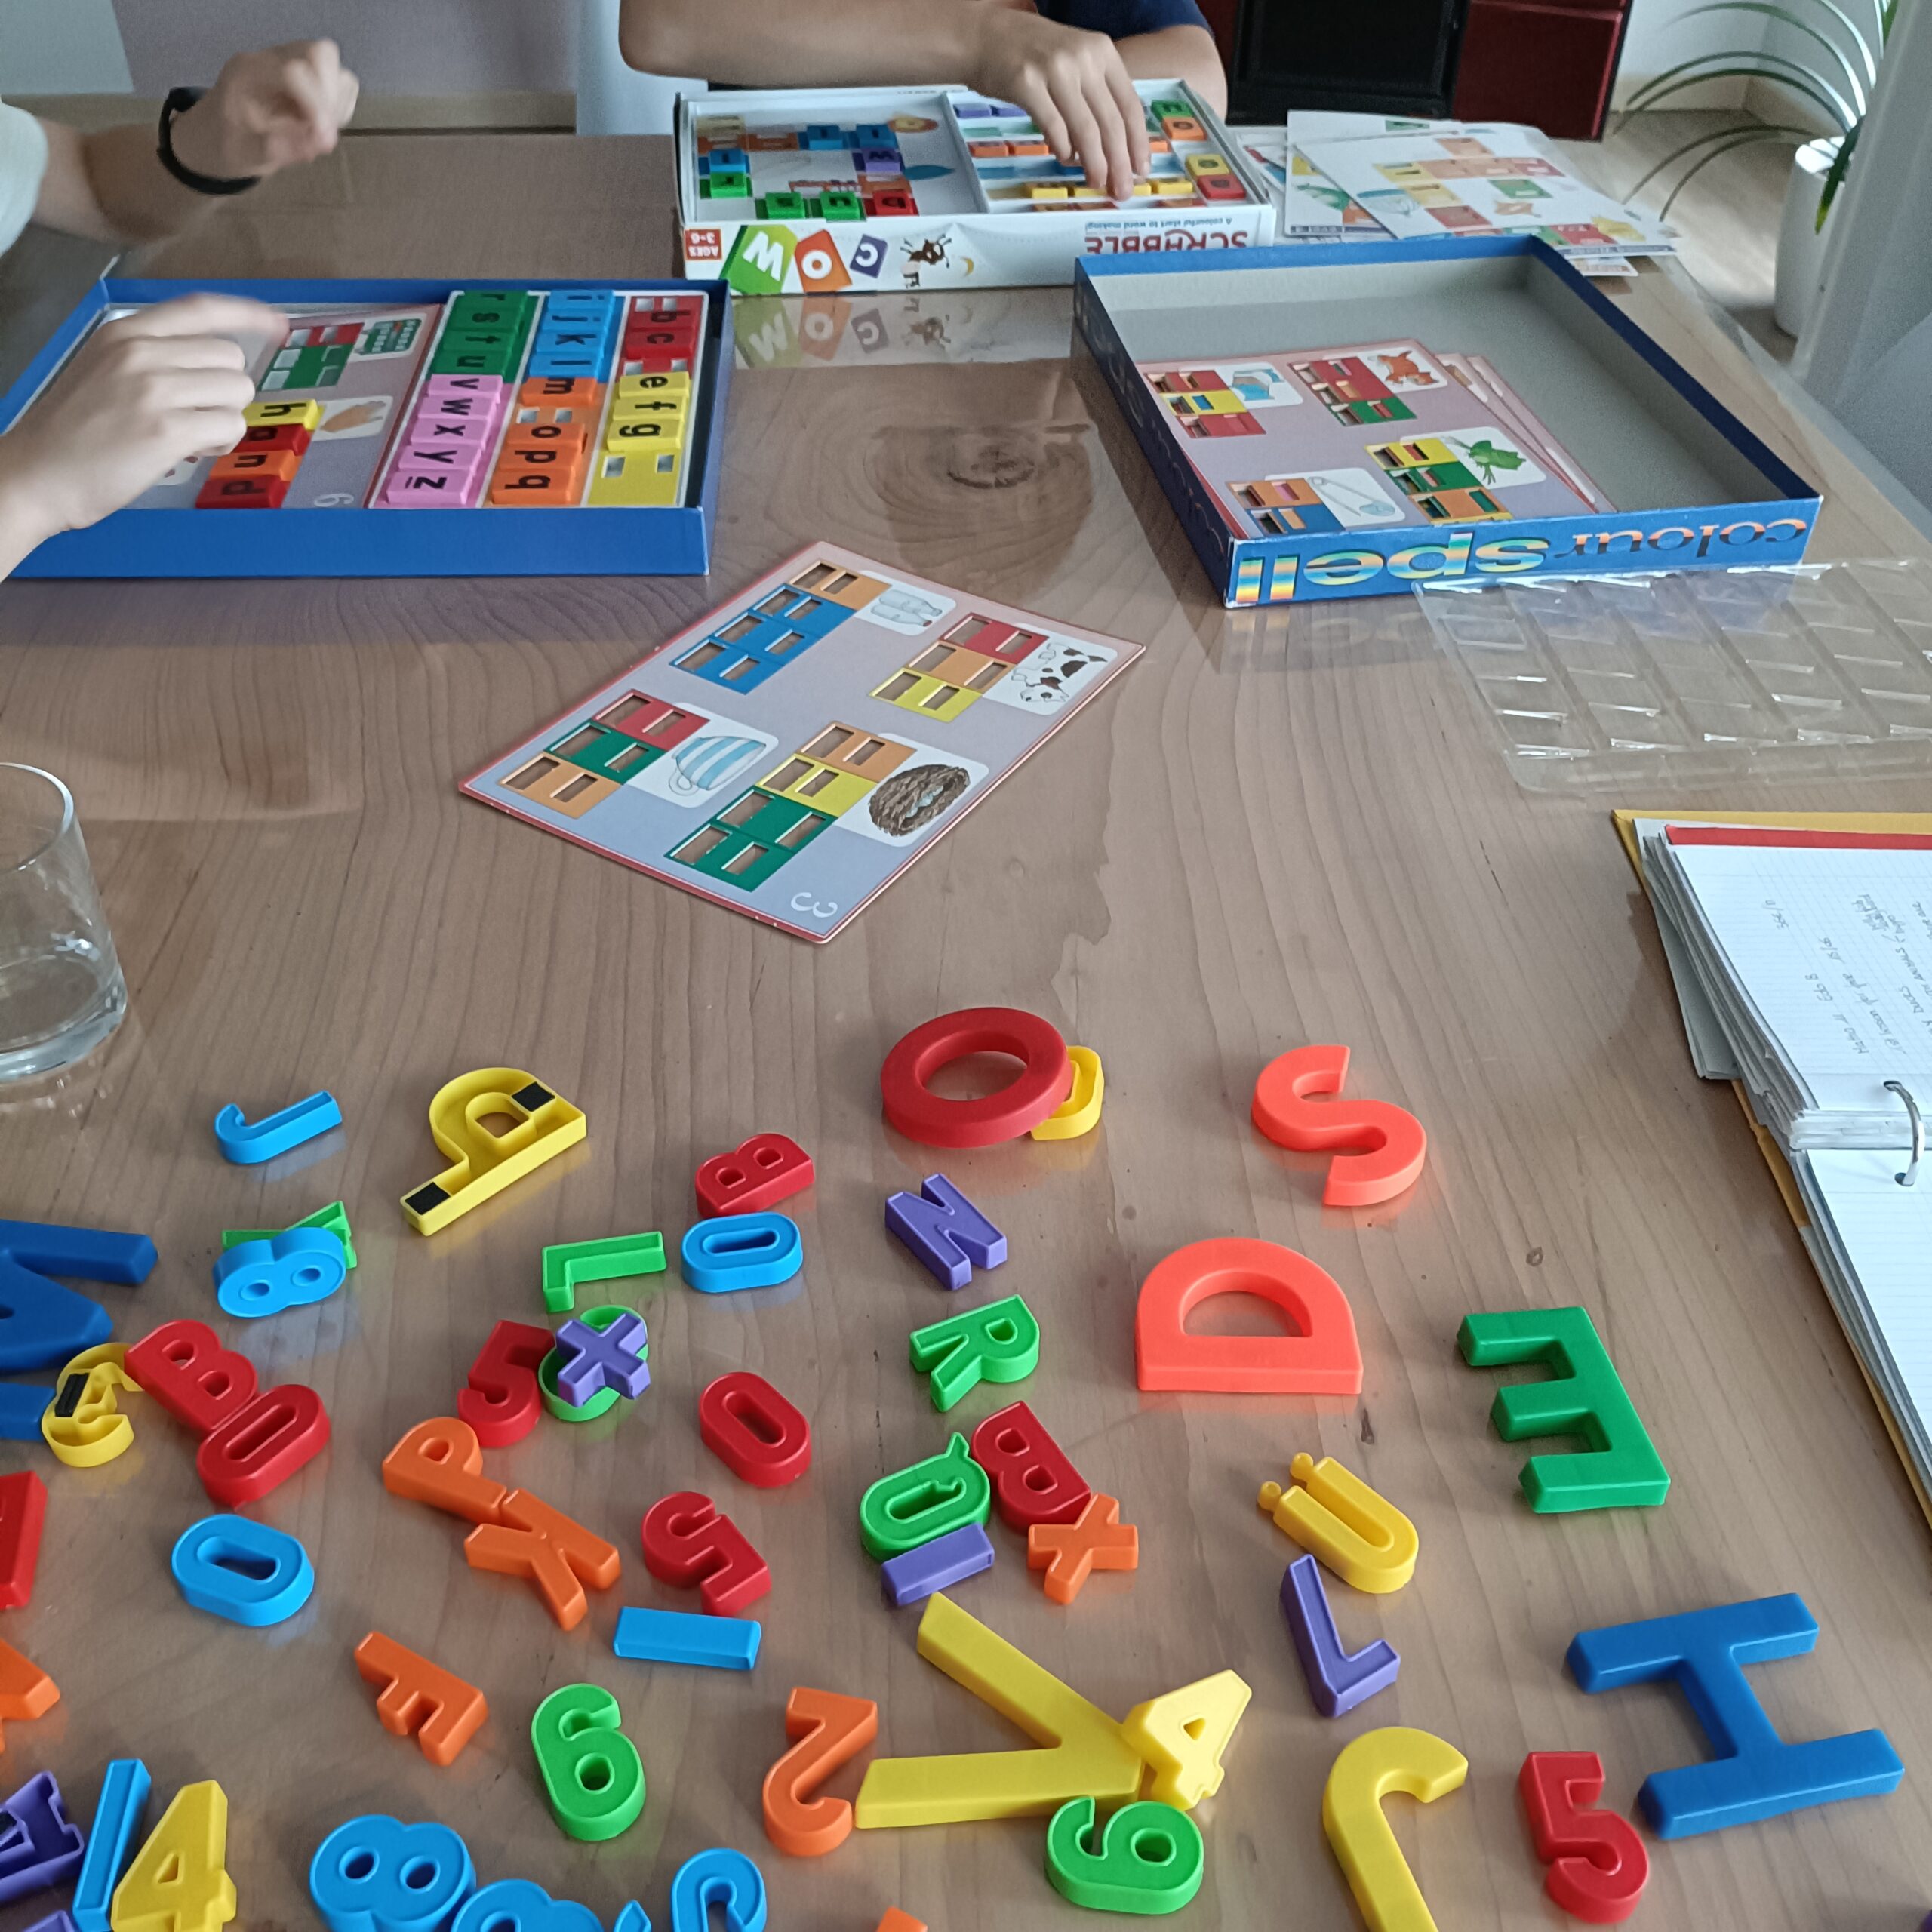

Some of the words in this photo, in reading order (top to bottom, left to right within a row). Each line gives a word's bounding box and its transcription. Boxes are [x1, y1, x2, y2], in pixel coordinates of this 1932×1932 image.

[689, 246, 718, 257] AGES
[640, 377, 668, 388] e
[1236, 531, 1550, 602] spell
[1555, 519, 1807, 559] colour
[791, 891, 838, 919] 3
[694, 1133, 815, 1220] B
[1251, 1044, 1426, 1208] S
[212, 1226, 346, 1318] 8
[543, 1231, 666, 1312] L
[1135, 1237, 1364, 1395] D
[123, 1319, 258, 1430] B
[457, 1320, 555, 1447] 5
[909, 1294, 1040, 1412] R
[1457, 1306, 1671, 1514] E
[382, 1417, 507, 1521] P
[860, 1432, 991, 1561] Q
[971, 1400, 1091, 1534] B
[464, 1488, 621, 1631] K
[355, 1632, 488, 1767] F
[1279, 1555, 1401, 1719] L
[531, 1683, 647, 1841] 6
[1122, 1671, 1252, 1812] 4
[112, 1780, 237, 1932] 4
[309, 1814, 477, 1932] 8
[1519, 1752, 1649, 1926] 5
